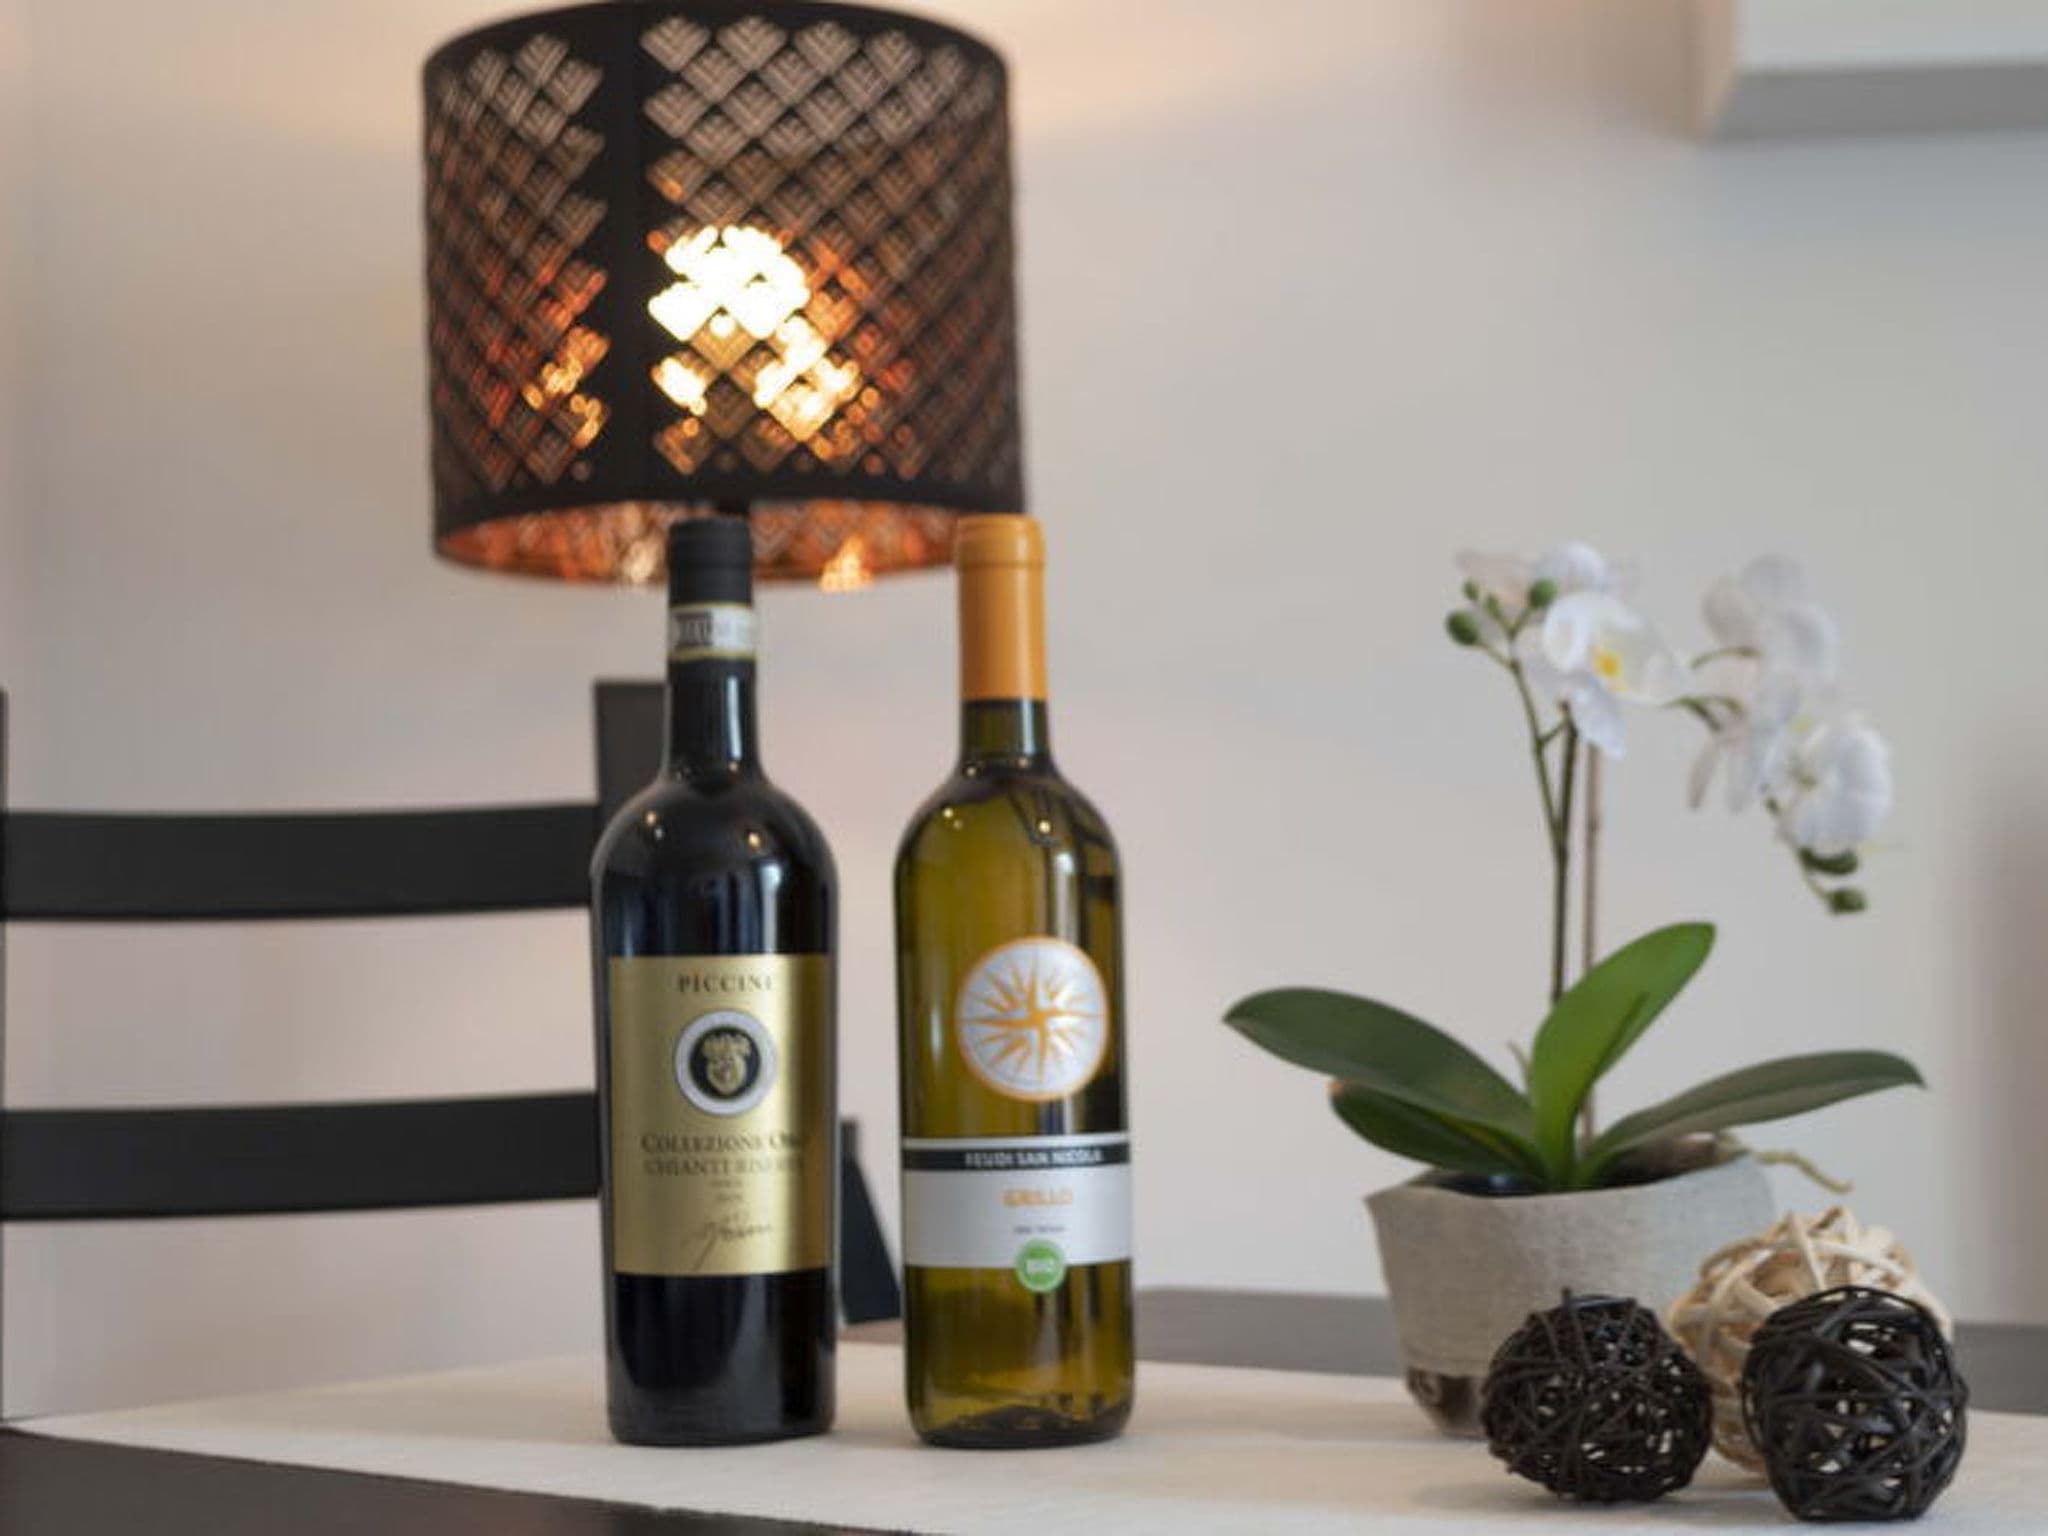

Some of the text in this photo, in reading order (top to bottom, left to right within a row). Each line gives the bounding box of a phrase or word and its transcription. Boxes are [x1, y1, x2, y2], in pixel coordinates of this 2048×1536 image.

[677, 974, 772, 993] PICCINI
[964, 1148, 1103, 1168] FEUDI SAN NICOLA
[1003, 1187, 1073, 1206] GRILLO
